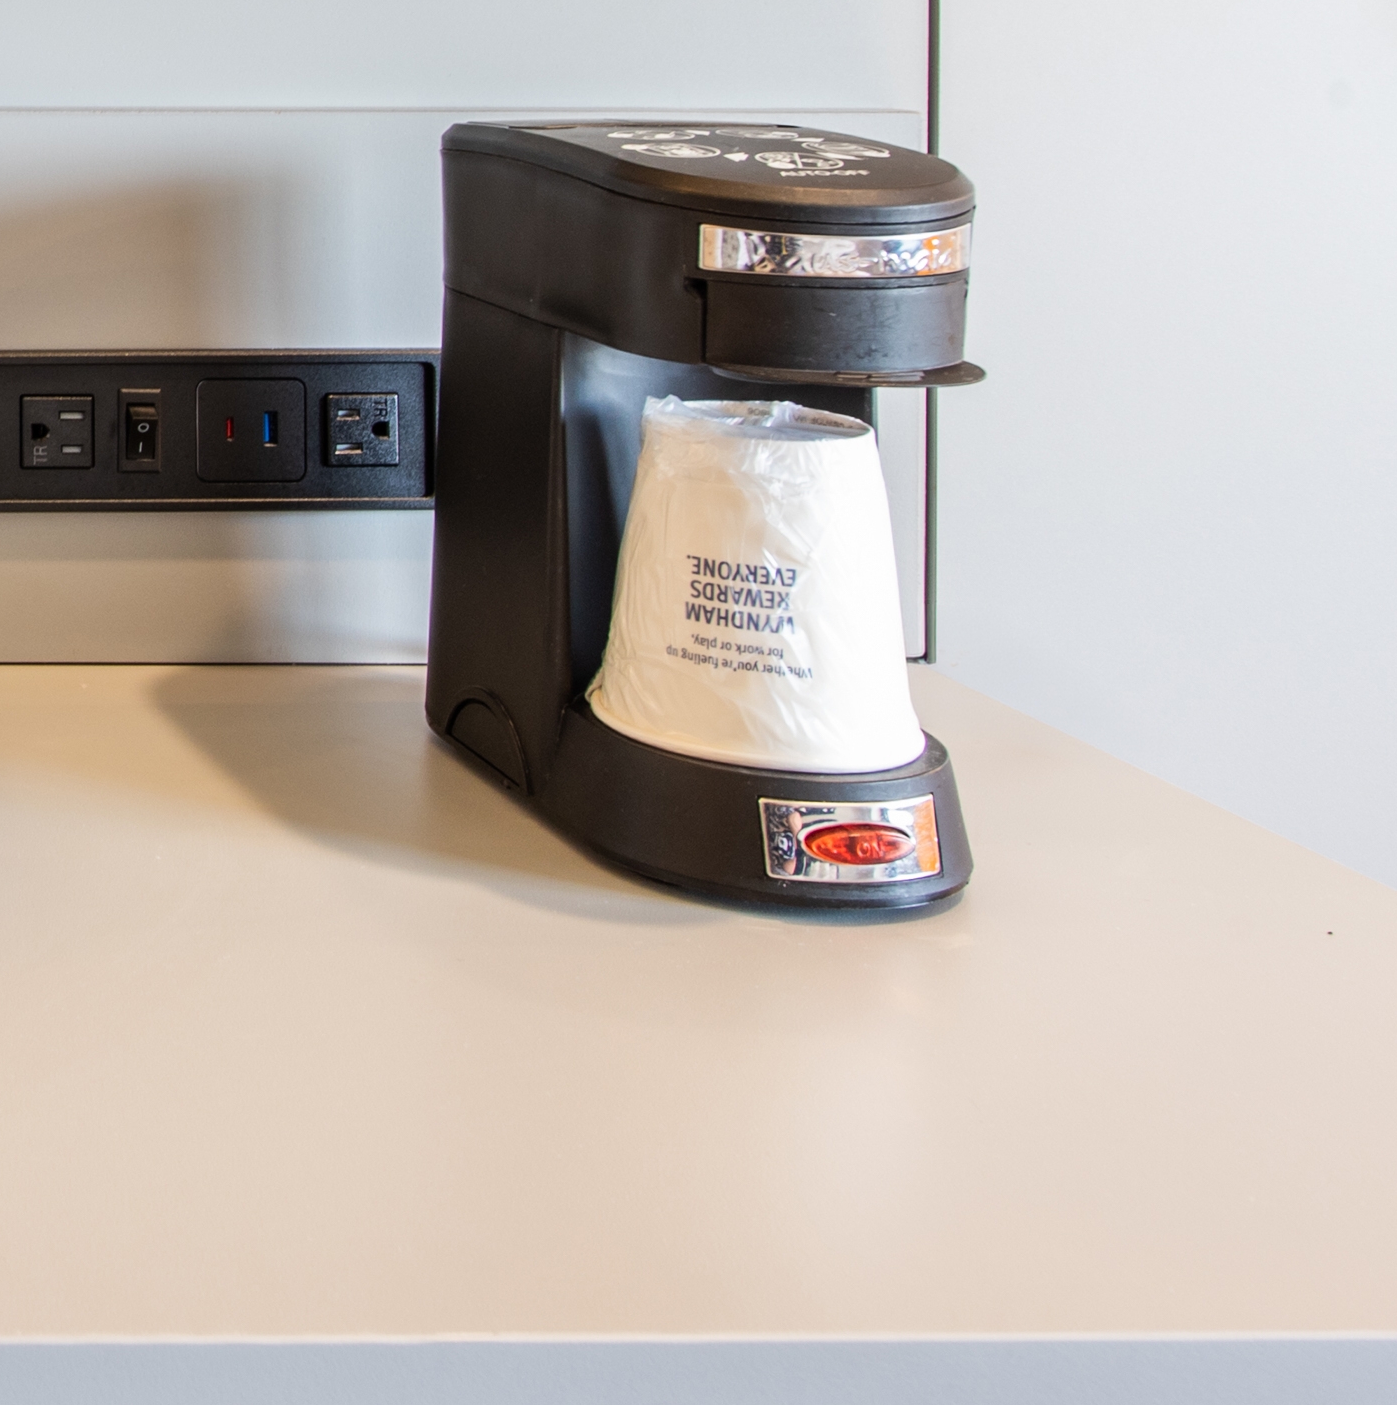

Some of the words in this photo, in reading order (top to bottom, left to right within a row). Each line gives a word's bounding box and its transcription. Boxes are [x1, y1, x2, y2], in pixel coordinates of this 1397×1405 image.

[33, 445, 47, 465] TR
[686, 554, 797, 587] EVERYONE.
[690, 579, 790, 610] REWARDS
[684, 601, 795, 634] WYNDHAM
[691, 633, 717, 648] play,
[720, 641, 732, 651] or
[666, 644, 678, 658] up
[735, 642, 764, 656] work
[766, 647, 784, 660] for
[681, 647, 719, 669] fueling
[721, 658, 759, 672] you're
[761, 663, 813, 679] Whether
